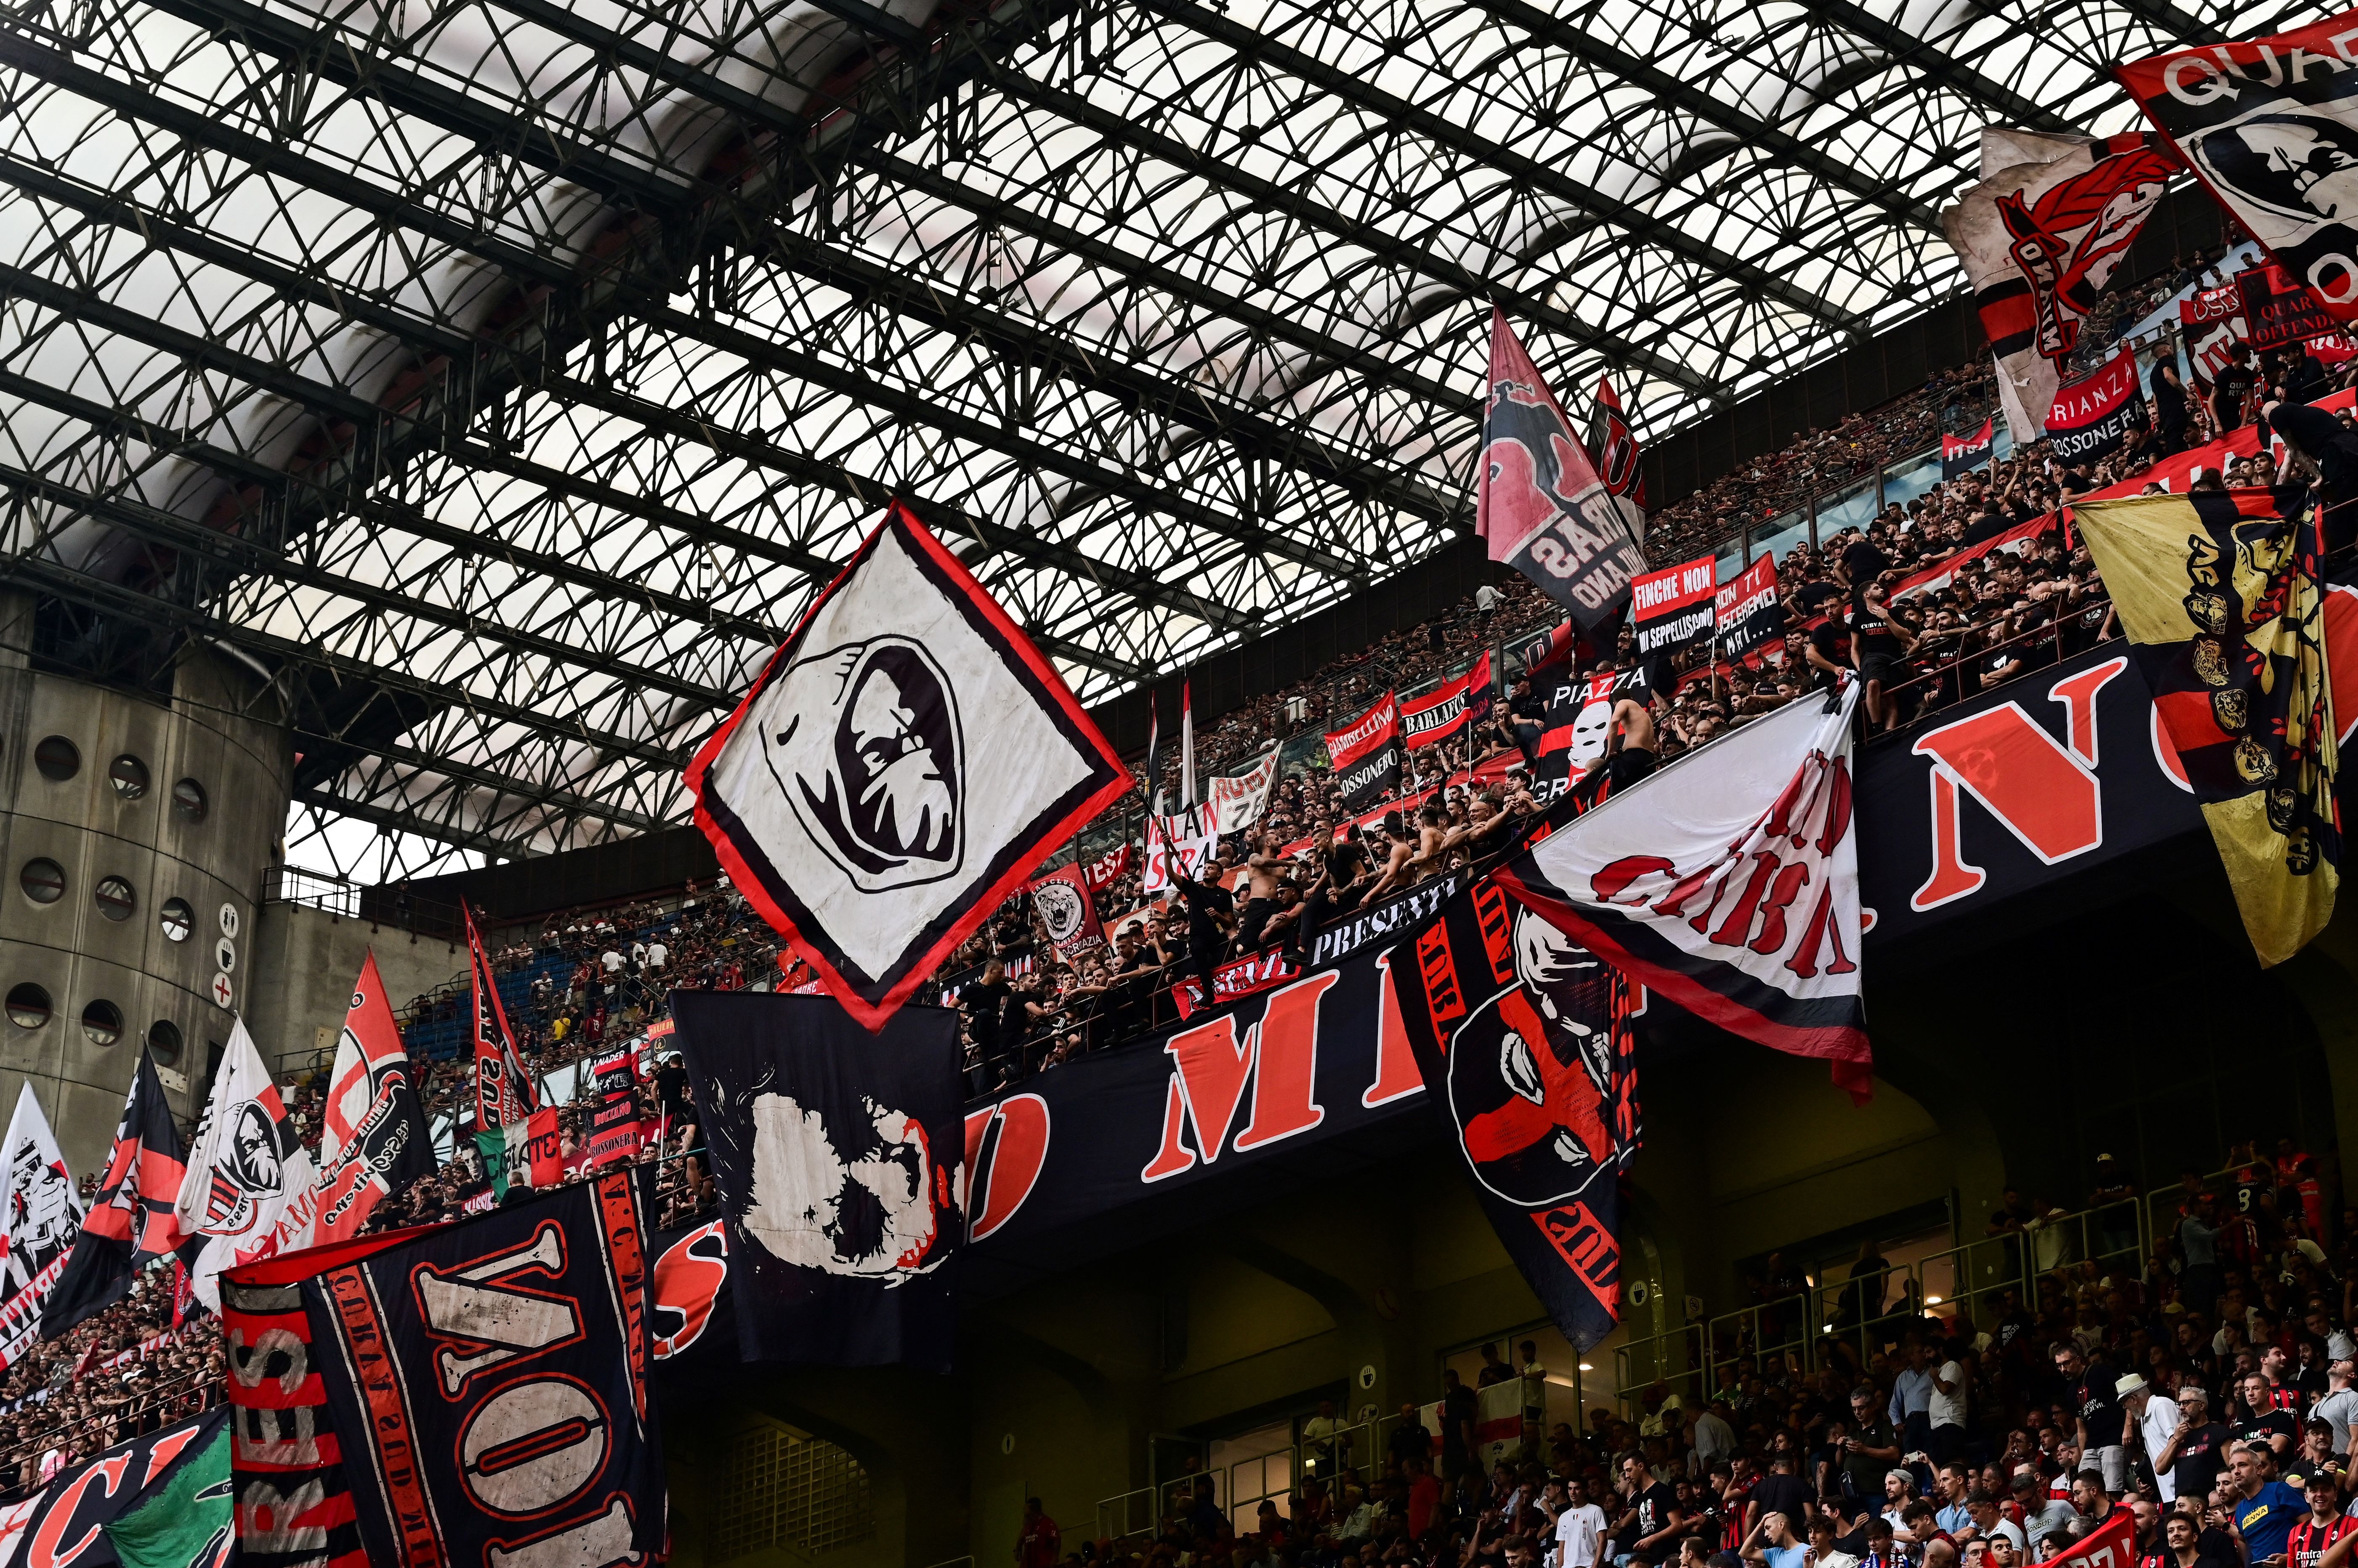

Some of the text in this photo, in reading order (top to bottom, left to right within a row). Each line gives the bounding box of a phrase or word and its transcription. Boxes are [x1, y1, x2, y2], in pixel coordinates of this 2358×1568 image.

[1634, 564, 1710, 610] FINCHÈ NON
[1744, 567, 1760, 592] TI
[1638, 606, 1713, 653] MI SEPPELLISCONO
[1861, 621, 1882, 630] CURVA
[1552, 666, 1647, 710] PIAZZA
[1328, 703, 1394, 759] GIAMBELLINO
[1340, 748, 1398, 798] OSSONERO
[1050, 878, 1075, 888] CLUB
[1311, 877, 1456, 967] PRESENTI
[594, 1101, 631, 1127] ROZZANO
[590, 1131, 639, 1159] ROSSONERA
[2243, 1508, 2267, 1527] SENNA
